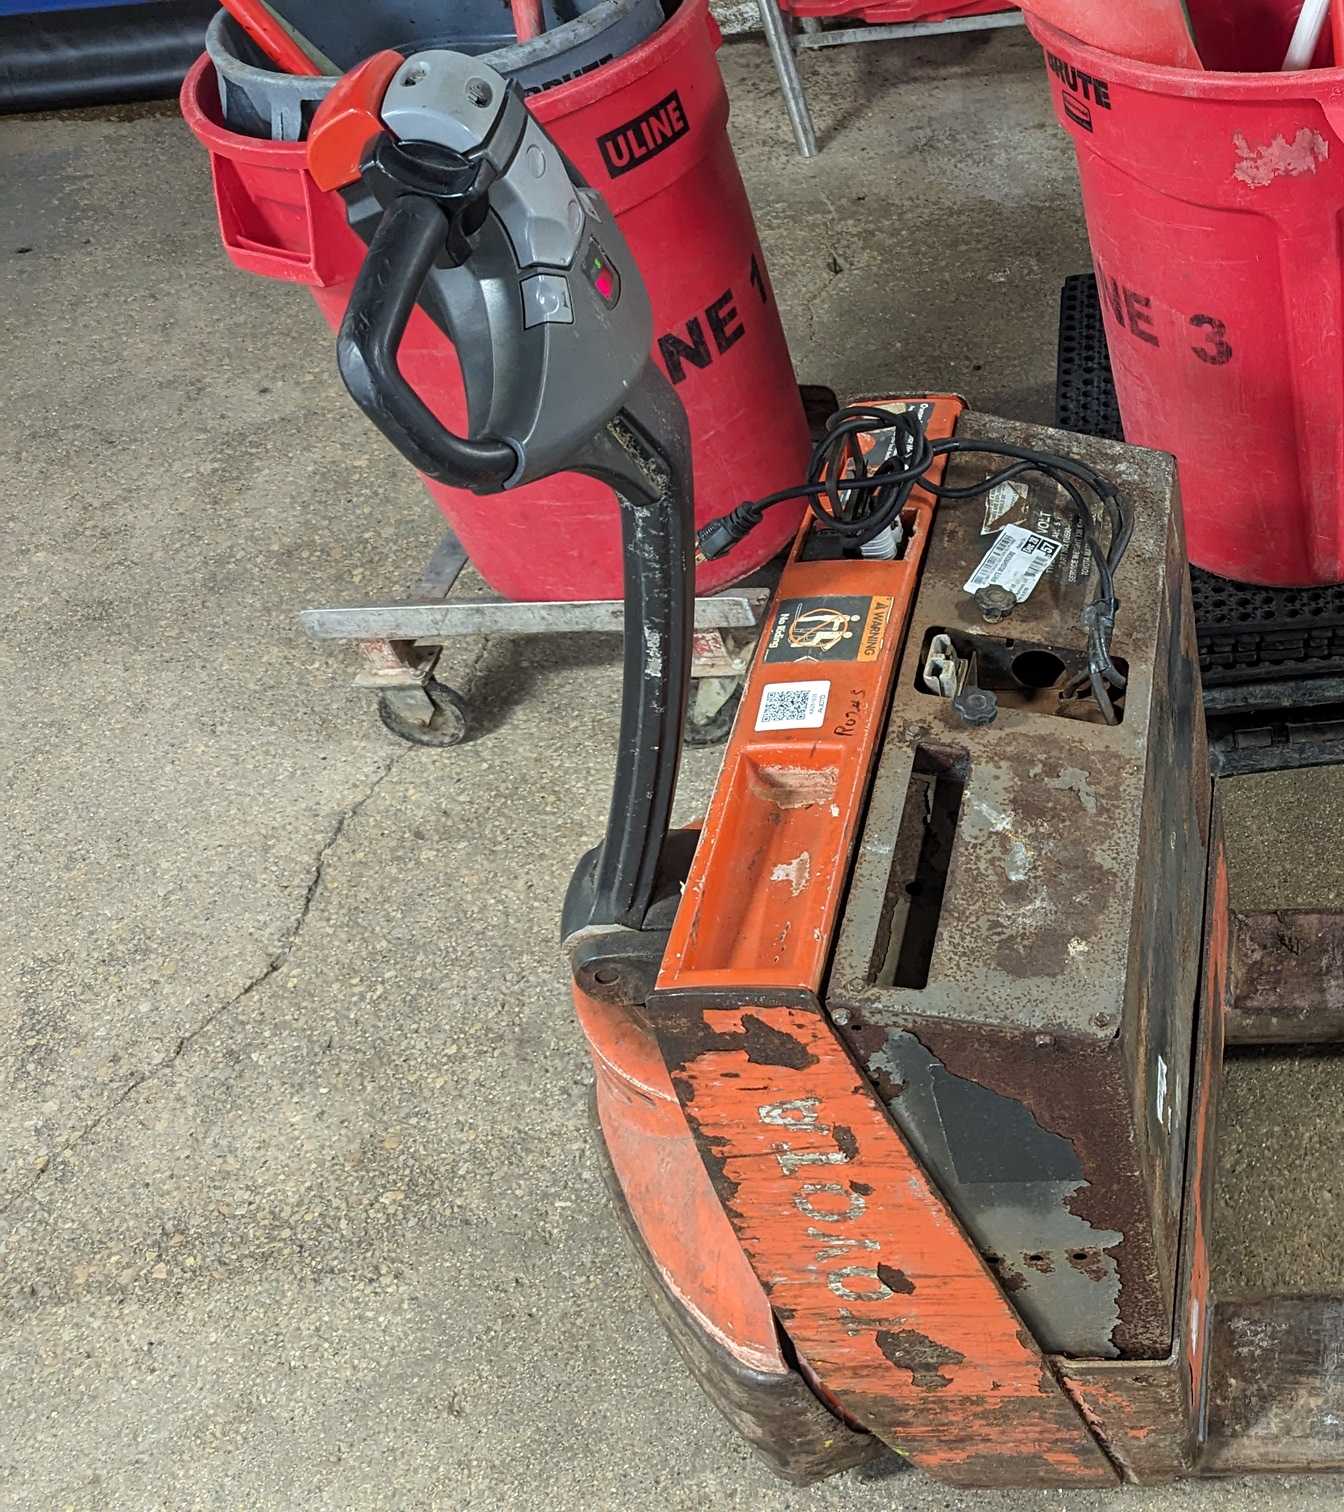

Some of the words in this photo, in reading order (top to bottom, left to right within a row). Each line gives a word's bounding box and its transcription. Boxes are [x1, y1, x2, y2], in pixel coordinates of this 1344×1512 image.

[604, 100, 685, 168] ULINE
[657, 287, 746, 385] NE
[750, 253, 768, 304] 1
[1189, 313, 1233, 366] 3
[769, 624, 787, 649] Riding
[778, 613, 791, 625] No
[864, 611, 888, 657] WARNING
